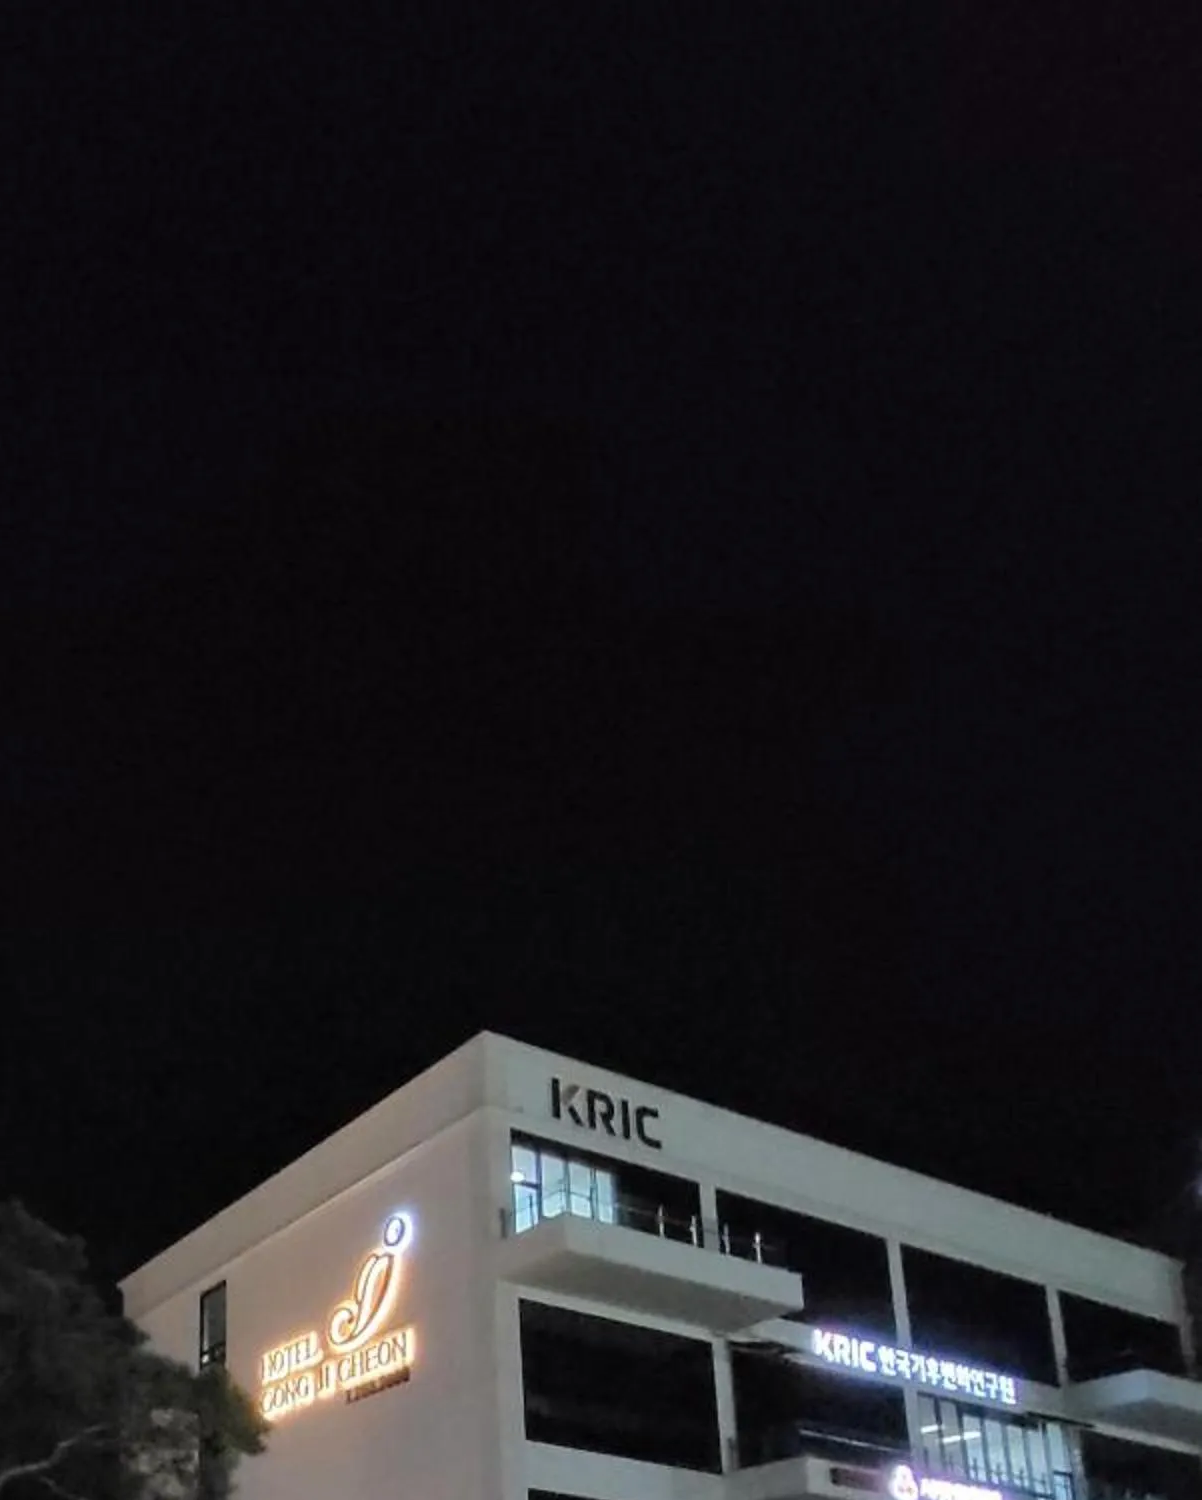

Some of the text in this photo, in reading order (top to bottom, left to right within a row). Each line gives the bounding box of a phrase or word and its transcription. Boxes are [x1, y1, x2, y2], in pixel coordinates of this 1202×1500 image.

[551, 1077, 662, 1150] KRIC
[260, 1374, 310, 1416] GONG
[337, 1329, 410, 1384] CHEON
[812, 1328, 877, 1373] KRIC
